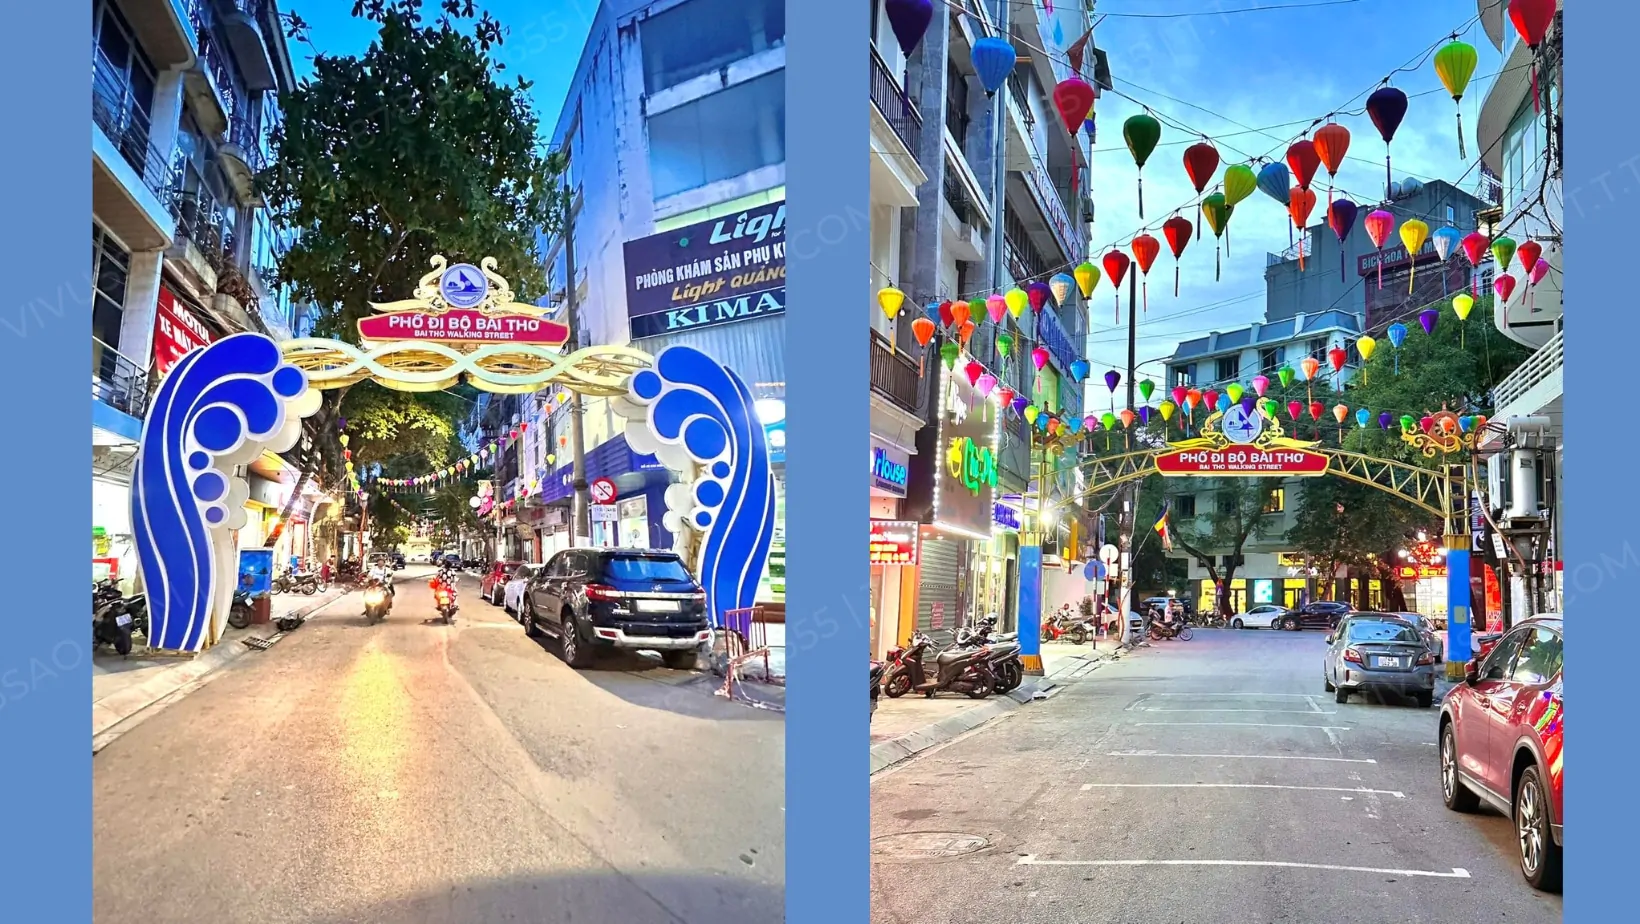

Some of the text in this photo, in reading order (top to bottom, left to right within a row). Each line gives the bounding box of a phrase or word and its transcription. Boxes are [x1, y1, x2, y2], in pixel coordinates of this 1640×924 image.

[635, 268, 674, 290] PHÒNG
[676, 257, 712, 281] KHÁM
[714, 250, 741, 272] SẢN
[744, 246, 771, 265] PHỤ
[671, 277, 726, 302] Light
[173, 299, 211, 345] MOTUL
[388, 313, 424, 329] PHỐ
[427, 316, 444, 330] ĐI
[449, 316, 473, 332] BỘ
[506, 318, 540, 332] THƠ
[666, 289, 785, 330] KIMA
[159, 312, 173, 339] XE
[414, 330, 514, 339] BAI THO WALKING STREET
[1179, 450, 1305, 465] PHỐ ĐI BỘ BÀI THƠ
